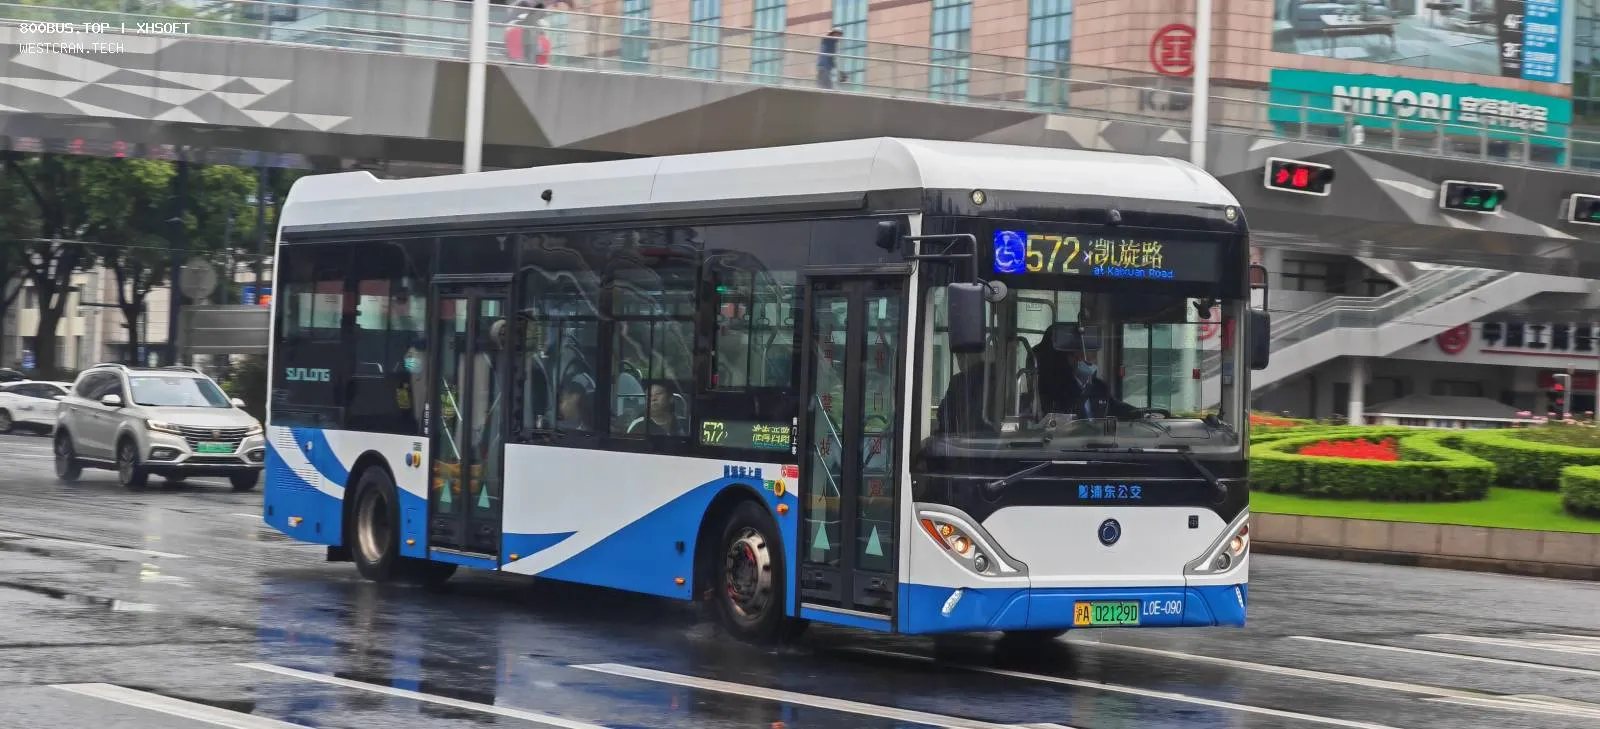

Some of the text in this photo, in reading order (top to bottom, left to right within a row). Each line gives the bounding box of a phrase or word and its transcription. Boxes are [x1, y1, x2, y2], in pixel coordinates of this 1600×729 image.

[1332, 84, 1451, 121] NITORI
[1026, 234, 1080, 274] 572
[1088, 238, 1163, 269] 凯旋路
[286, 367, 331, 381] SUNLONG
[703, 421, 725, 444] 572
[1090, 484, 1142, 499] 浦东公交
[1095, 605, 1138, 622] 02129D
